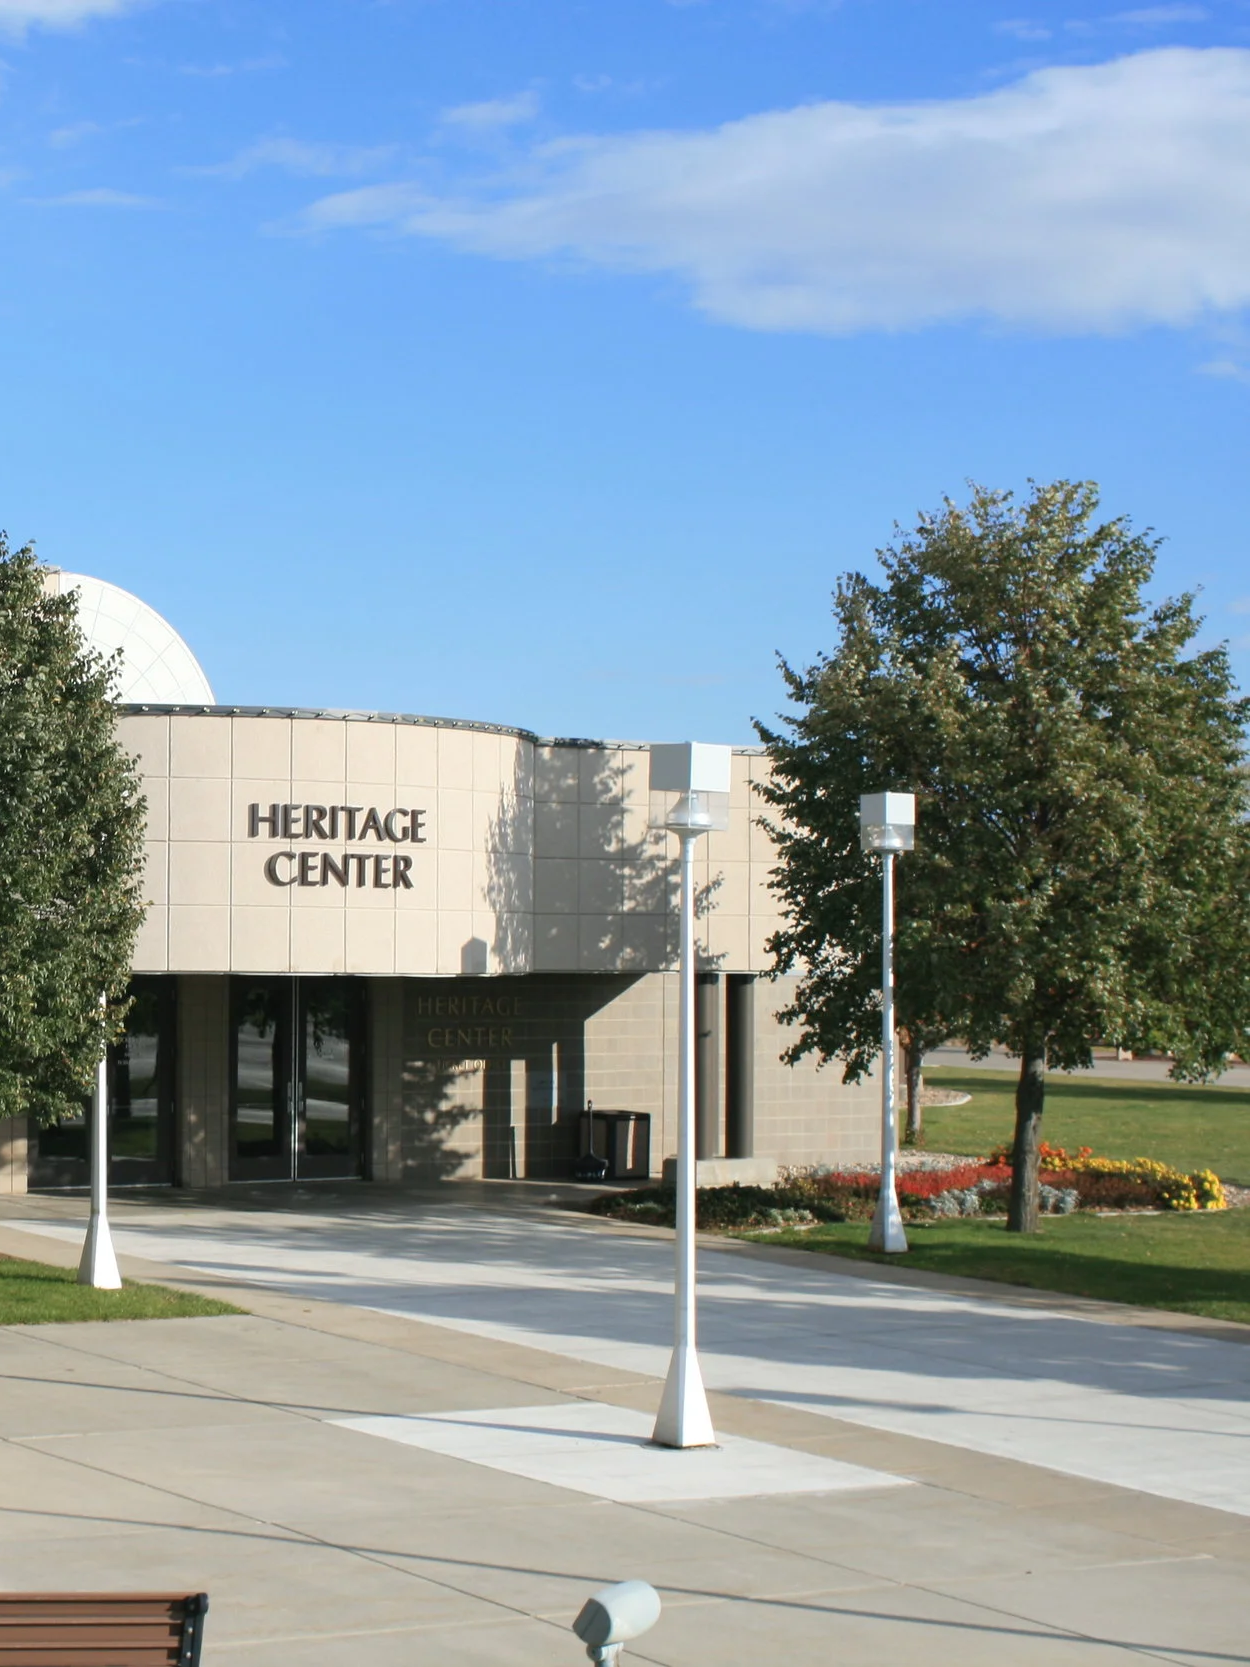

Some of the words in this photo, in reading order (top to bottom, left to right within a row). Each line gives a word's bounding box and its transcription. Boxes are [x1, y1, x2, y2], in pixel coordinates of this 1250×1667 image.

[248, 803, 427, 843] HERITAGE
[264, 851, 414, 889] CENTER
[418, 996, 523, 1016] HERITAGE
[427, 1027, 513, 1048] CENTER
